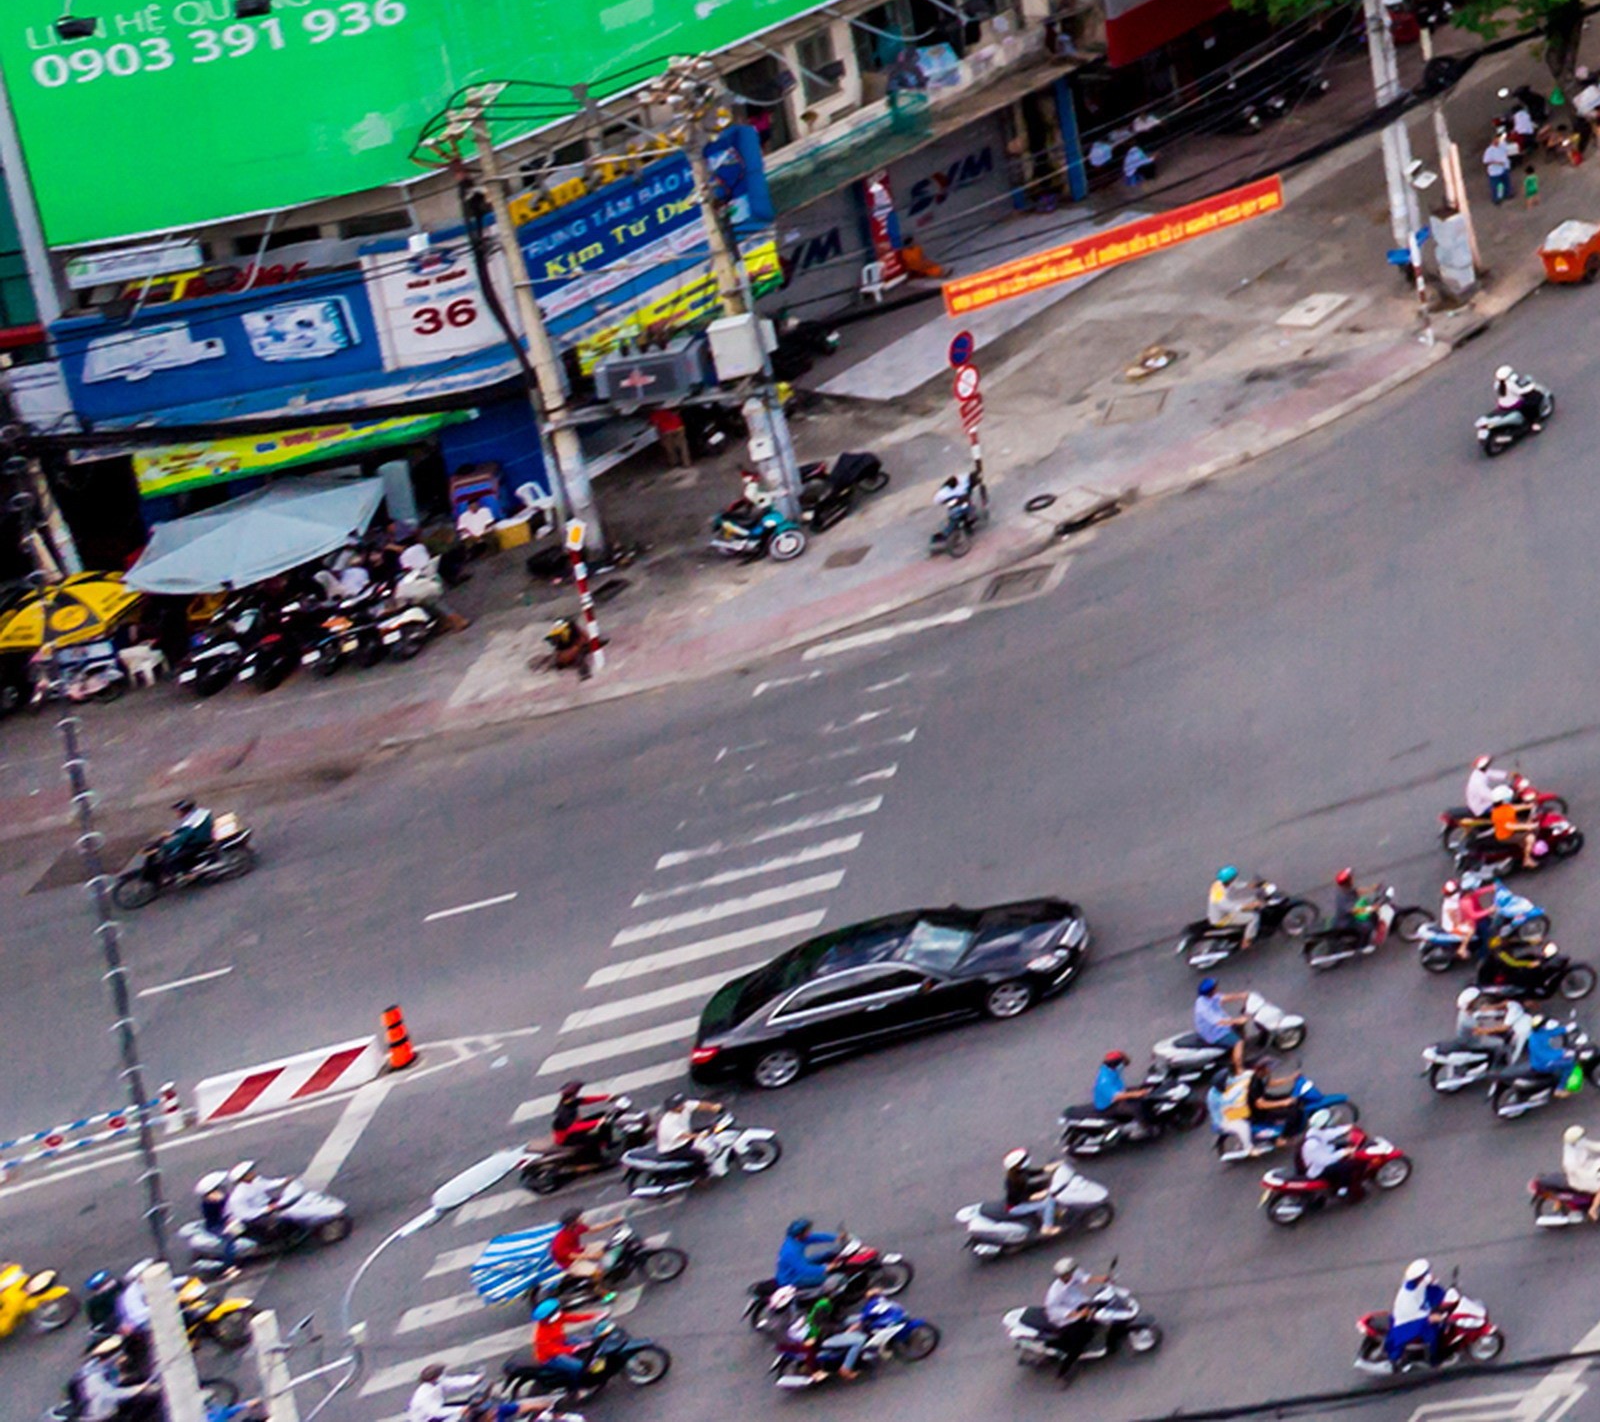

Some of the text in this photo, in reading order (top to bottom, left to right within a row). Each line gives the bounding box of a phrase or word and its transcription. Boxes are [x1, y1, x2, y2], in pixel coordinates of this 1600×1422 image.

[25, 14, 107, 51] LIN
[31, 36, 176, 88] 0903
[189, 17, 286, 64] 391
[543, 240, 604, 279] Kim
[411, 297, 478, 336] 36
